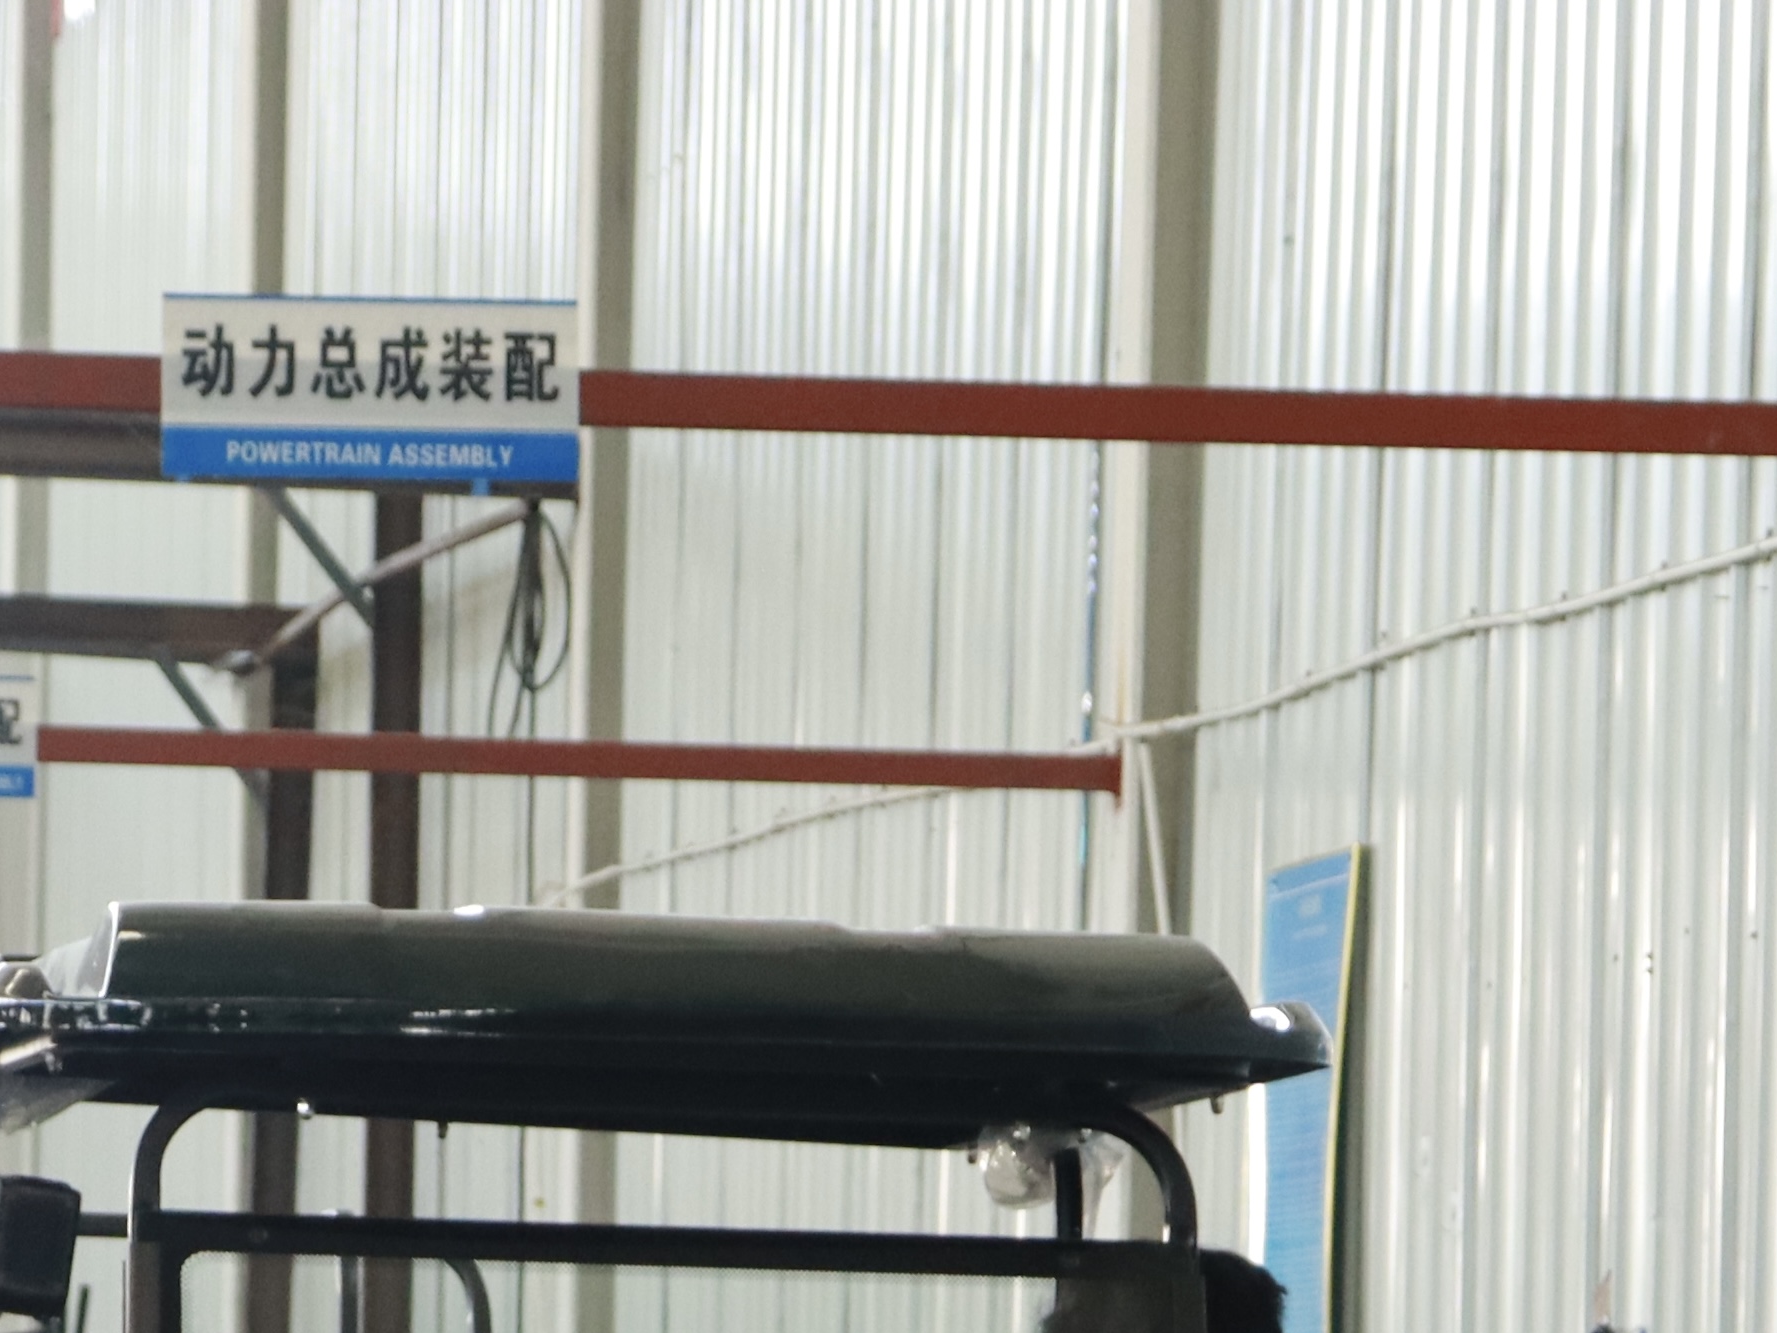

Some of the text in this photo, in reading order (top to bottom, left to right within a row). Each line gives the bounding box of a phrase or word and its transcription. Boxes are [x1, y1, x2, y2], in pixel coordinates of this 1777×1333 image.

[181, 324, 560, 401] 动力总成装配
[226, 440, 514, 467] POWERTRAIN ASSEMBLY
